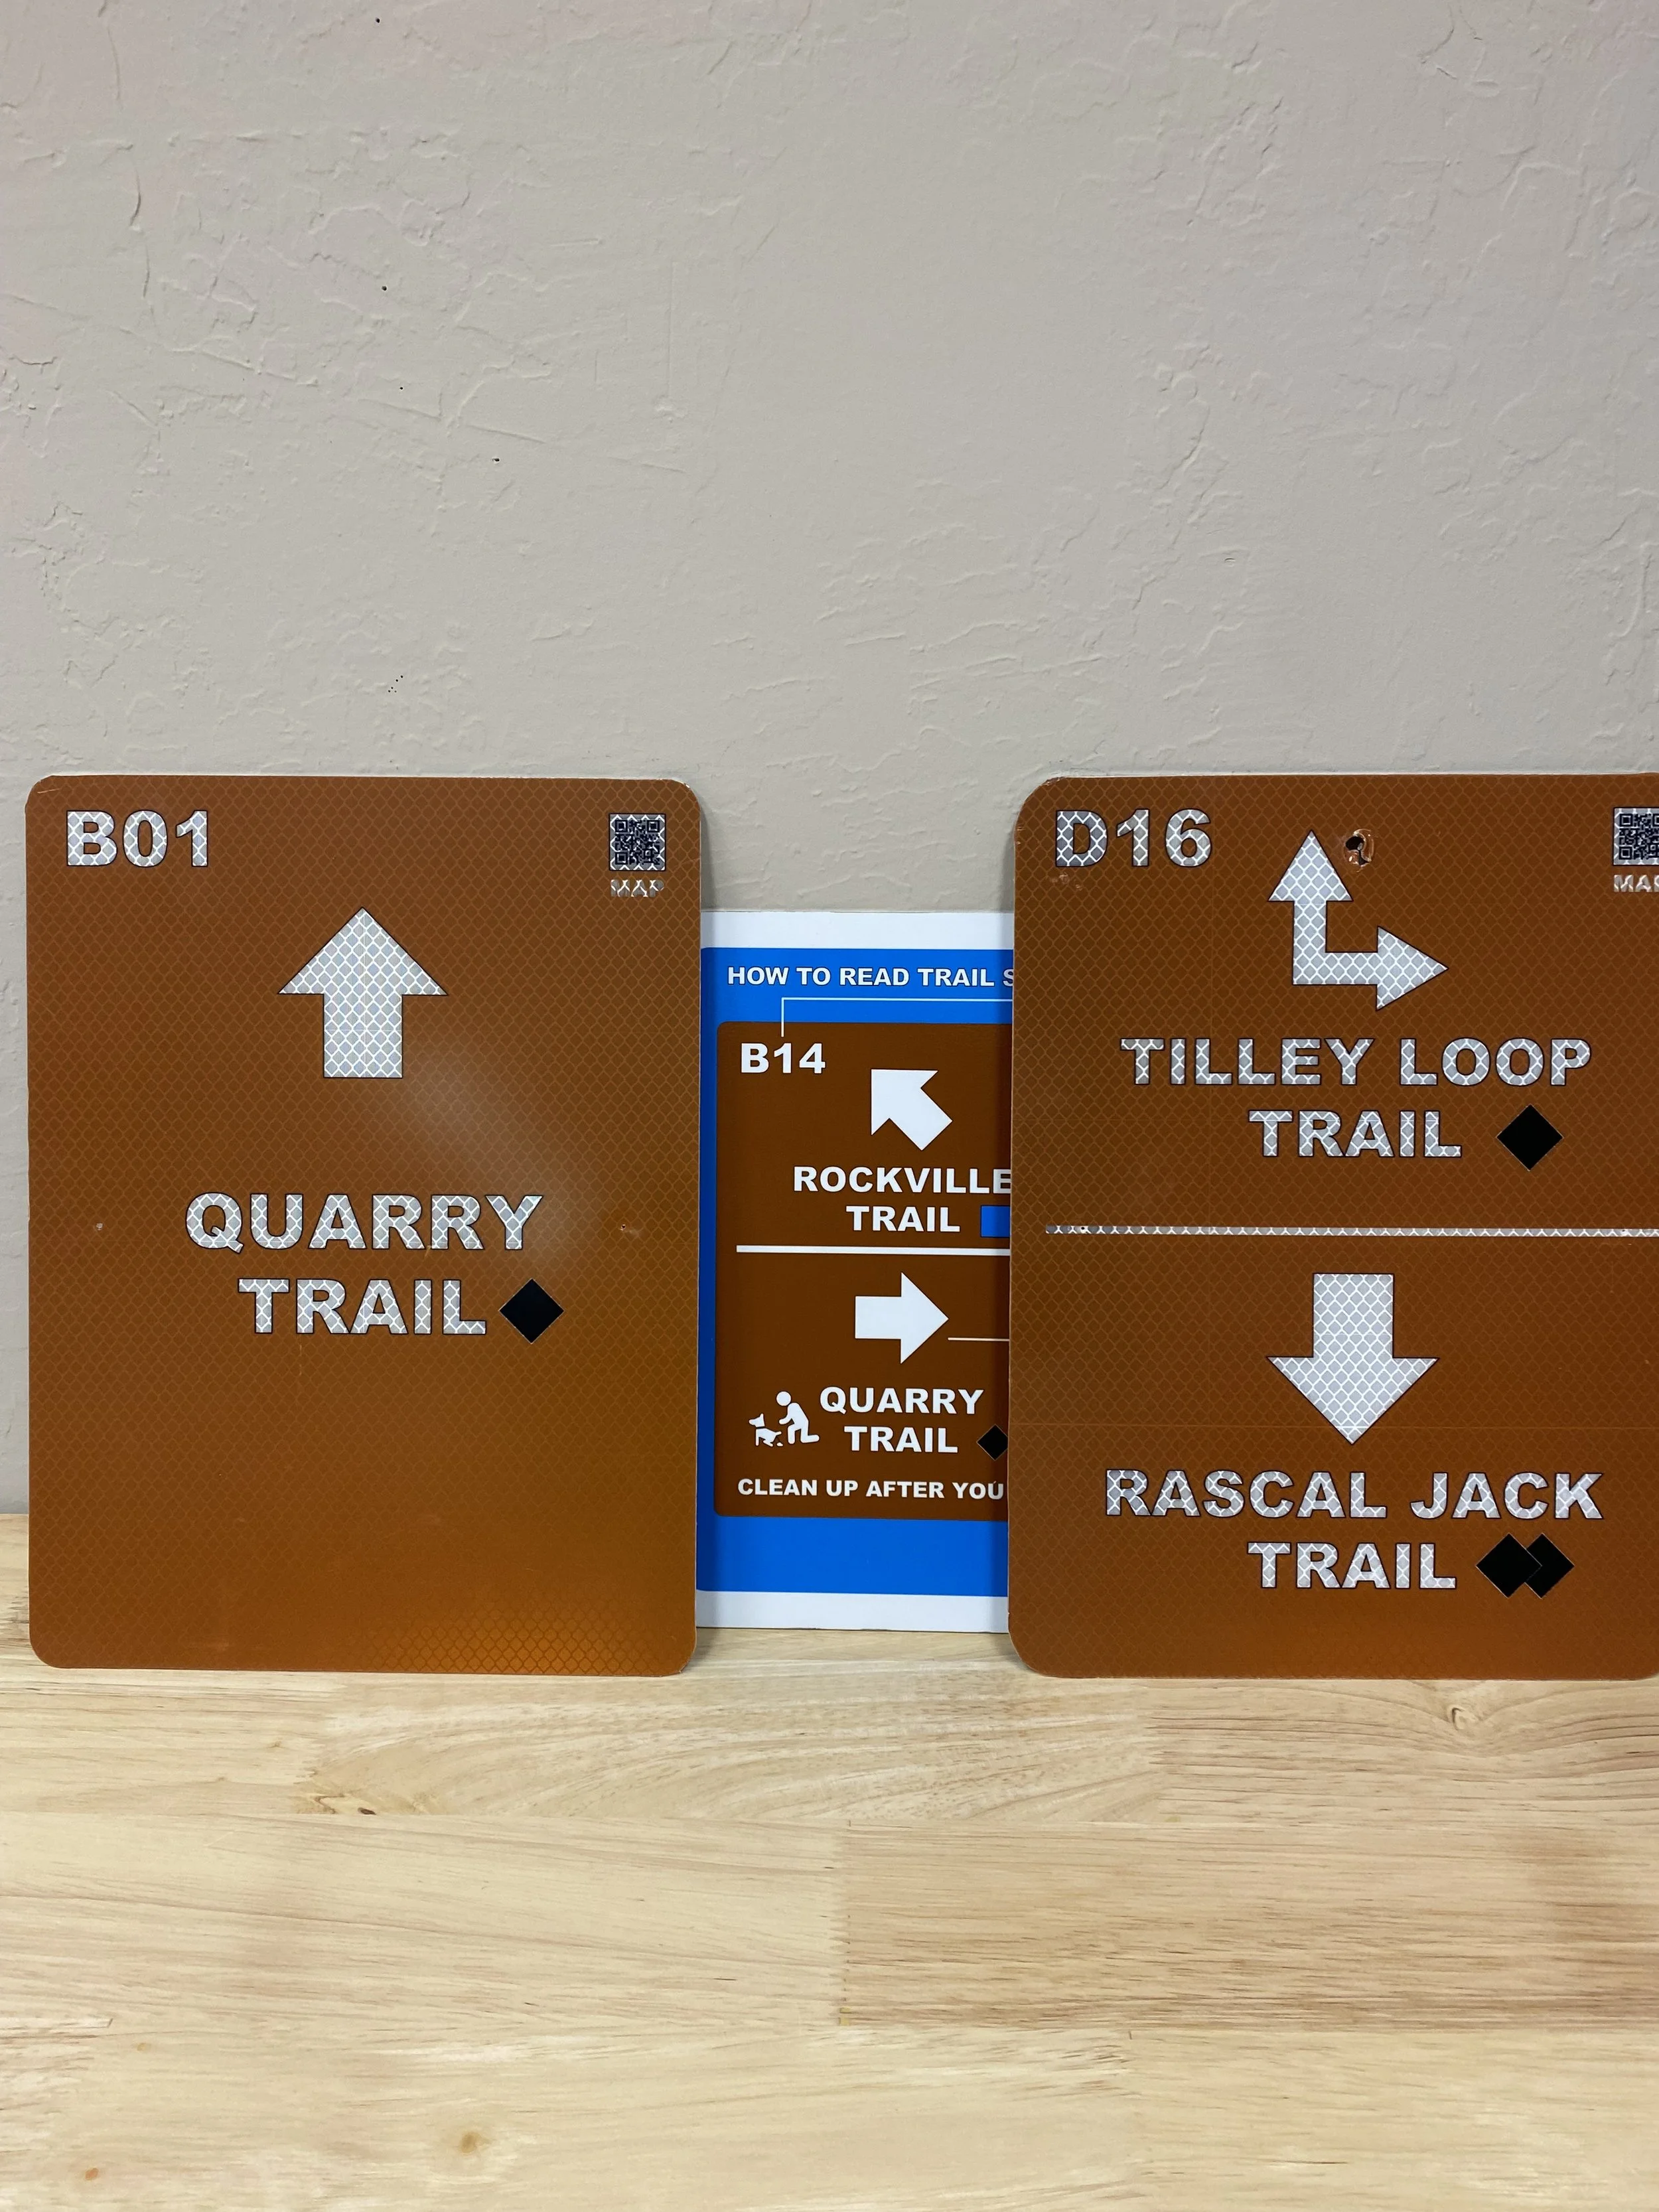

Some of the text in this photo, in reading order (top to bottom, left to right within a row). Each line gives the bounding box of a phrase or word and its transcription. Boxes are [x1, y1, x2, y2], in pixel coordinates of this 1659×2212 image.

[66, 810, 209, 867] B01
[1055, 808, 1212, 867] D16
[611, 879, 664, 897] MAP
[727, 966, 789, 986] HOW
[796, 967, 831, 986] TO
[839, 967, 909, 986] READ
[917, 968, 994, 987] TRAIL
[740, 1043, 826, 1074] B14
[1121, 1038, 1591, 1086] TILLEY LOOP
[1249, 1110, 1462, 1158] TRAIL
[794, 1166, 1011, 1194] ROCKVILLE
[185, 1193, 543, 1254] QUARRY
[845, 1206, 961, 1232] TRAIL
[238, 1278, 487, 1335] TRAIL
[820, 1386, 984, 1416] QUARRY
[844, 1426, 958, 1453] TRAIL
[737, 1479, 818, 1496] CLEAN
[826, 1480, 859, 1497] UP
[866, 1481, 944, 1499] AFTER
[1105, 1469, 1604, 1520] RASCAL JACK
[1247, 1542, 1456, 1589] TRAIL
